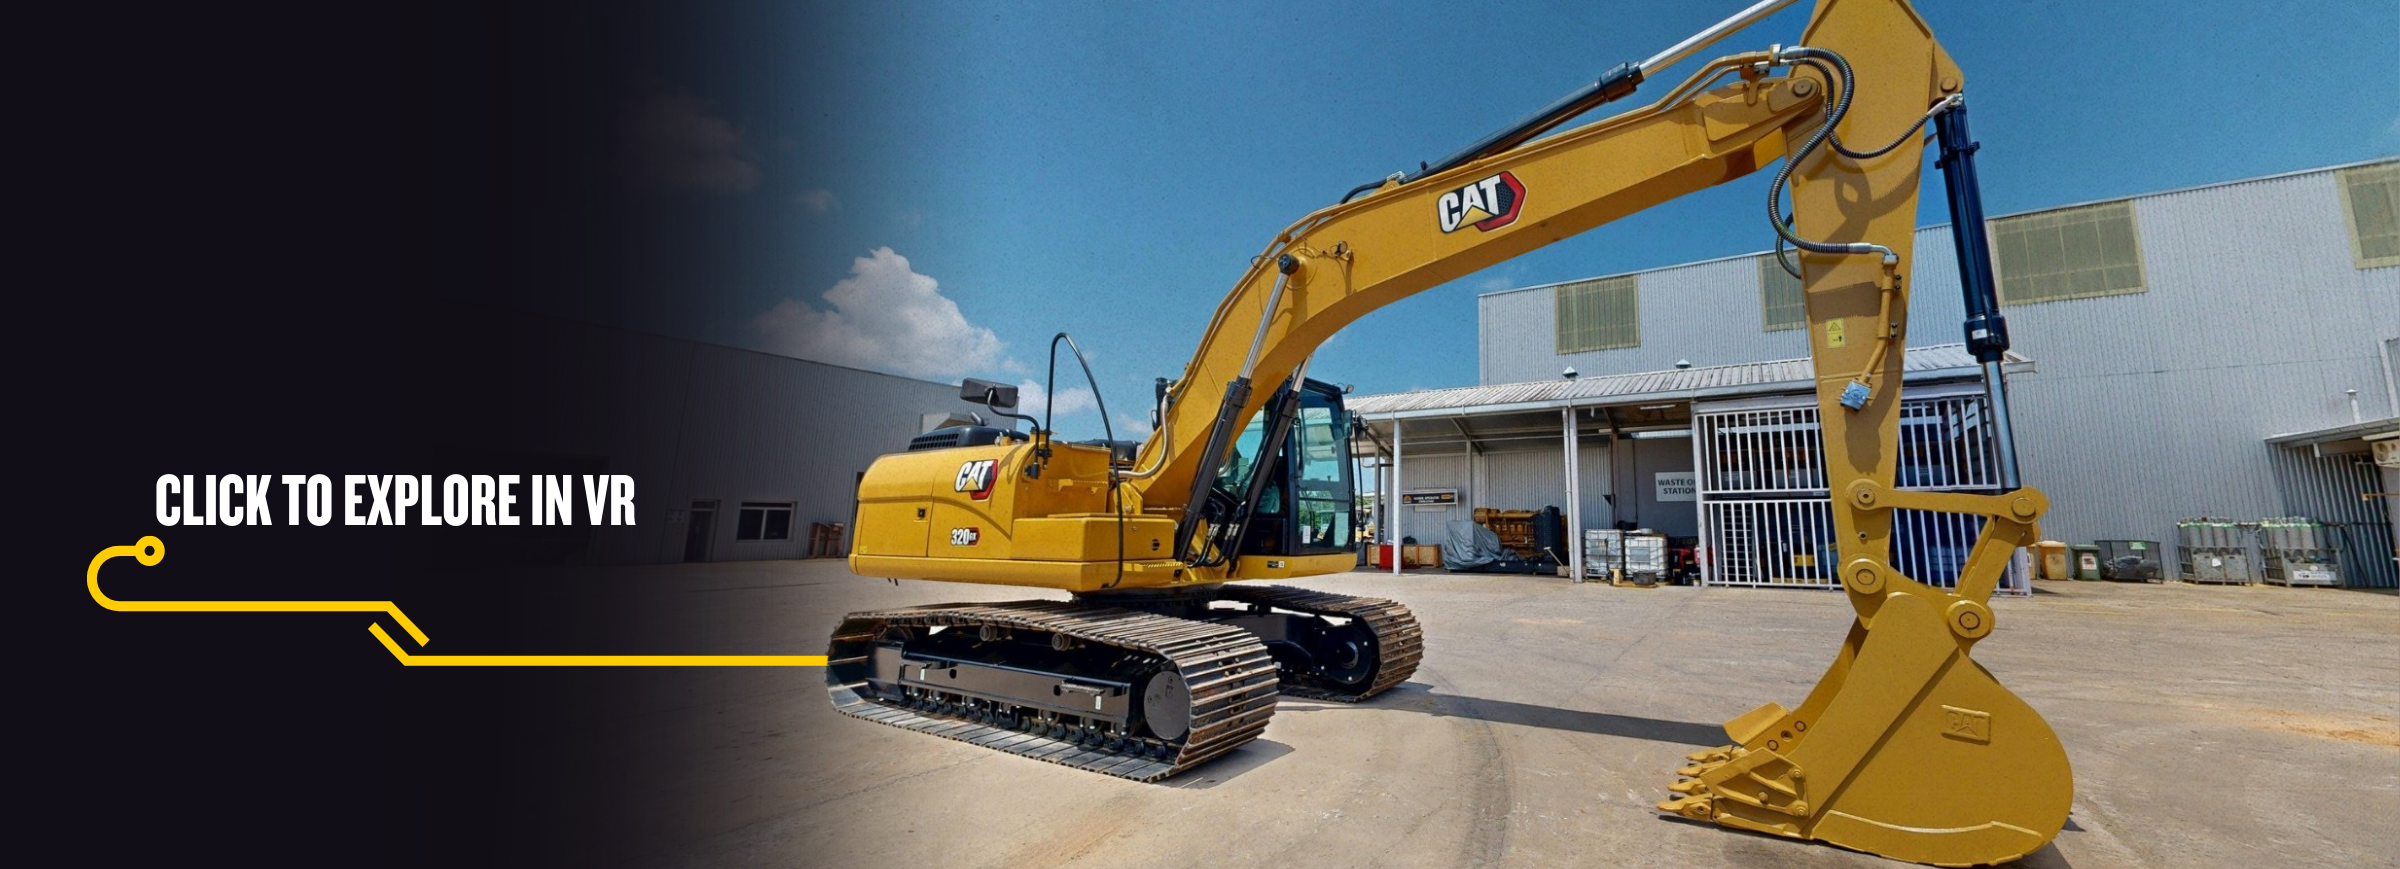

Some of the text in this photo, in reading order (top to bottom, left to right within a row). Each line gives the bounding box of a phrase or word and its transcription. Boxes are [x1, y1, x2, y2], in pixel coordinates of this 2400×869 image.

[1438, 174, 1501, 233] CAT
[955, 460, 994, 491] CAT
[1946, 710, 1986, 734] CAT
